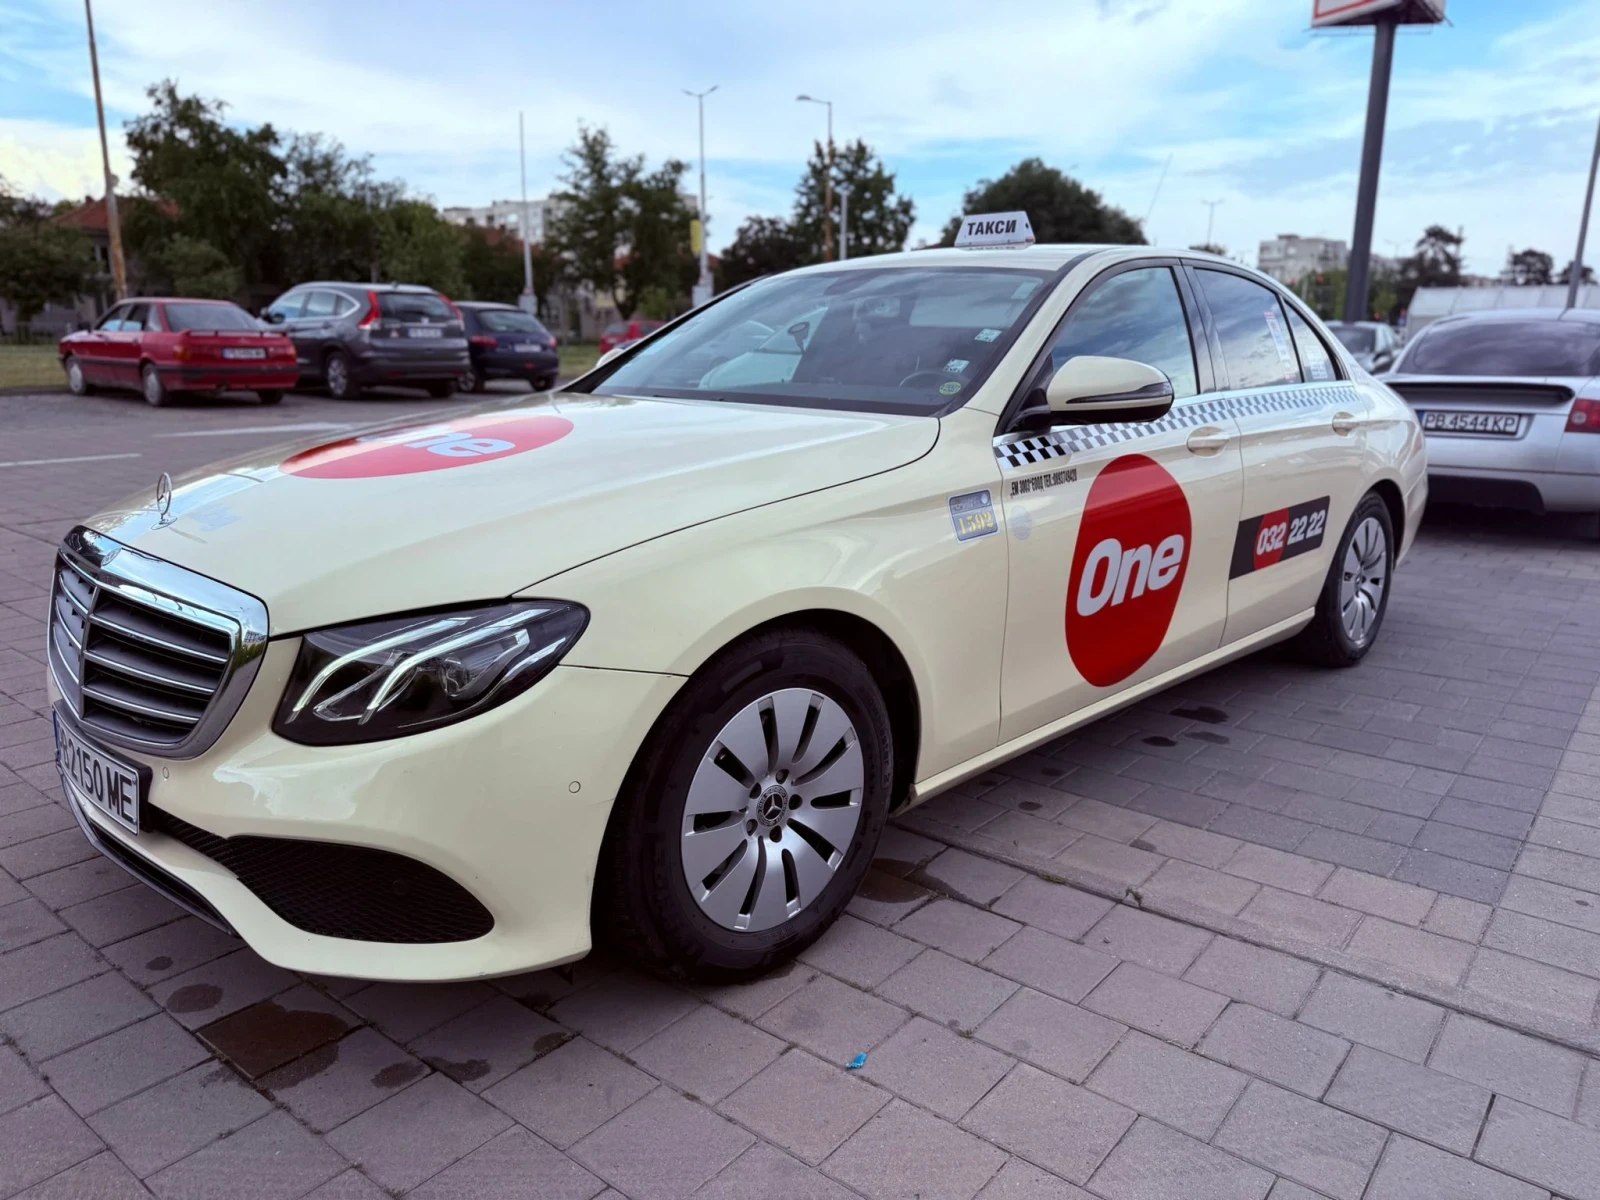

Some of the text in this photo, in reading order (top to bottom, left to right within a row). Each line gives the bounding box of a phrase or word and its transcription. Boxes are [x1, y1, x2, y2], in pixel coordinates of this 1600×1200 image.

[967, 219, 1017, 236] ТАКСИ
[1448, 414, 1490, 431] 4544
[958, 511, 994, 535] 1592
[1256, 509, 1326, 556] 032 22 22
[1076, 534, 1185, 617] One
[68, 738, 104, 802] 2150
[106, 766, 135, 824] ME
